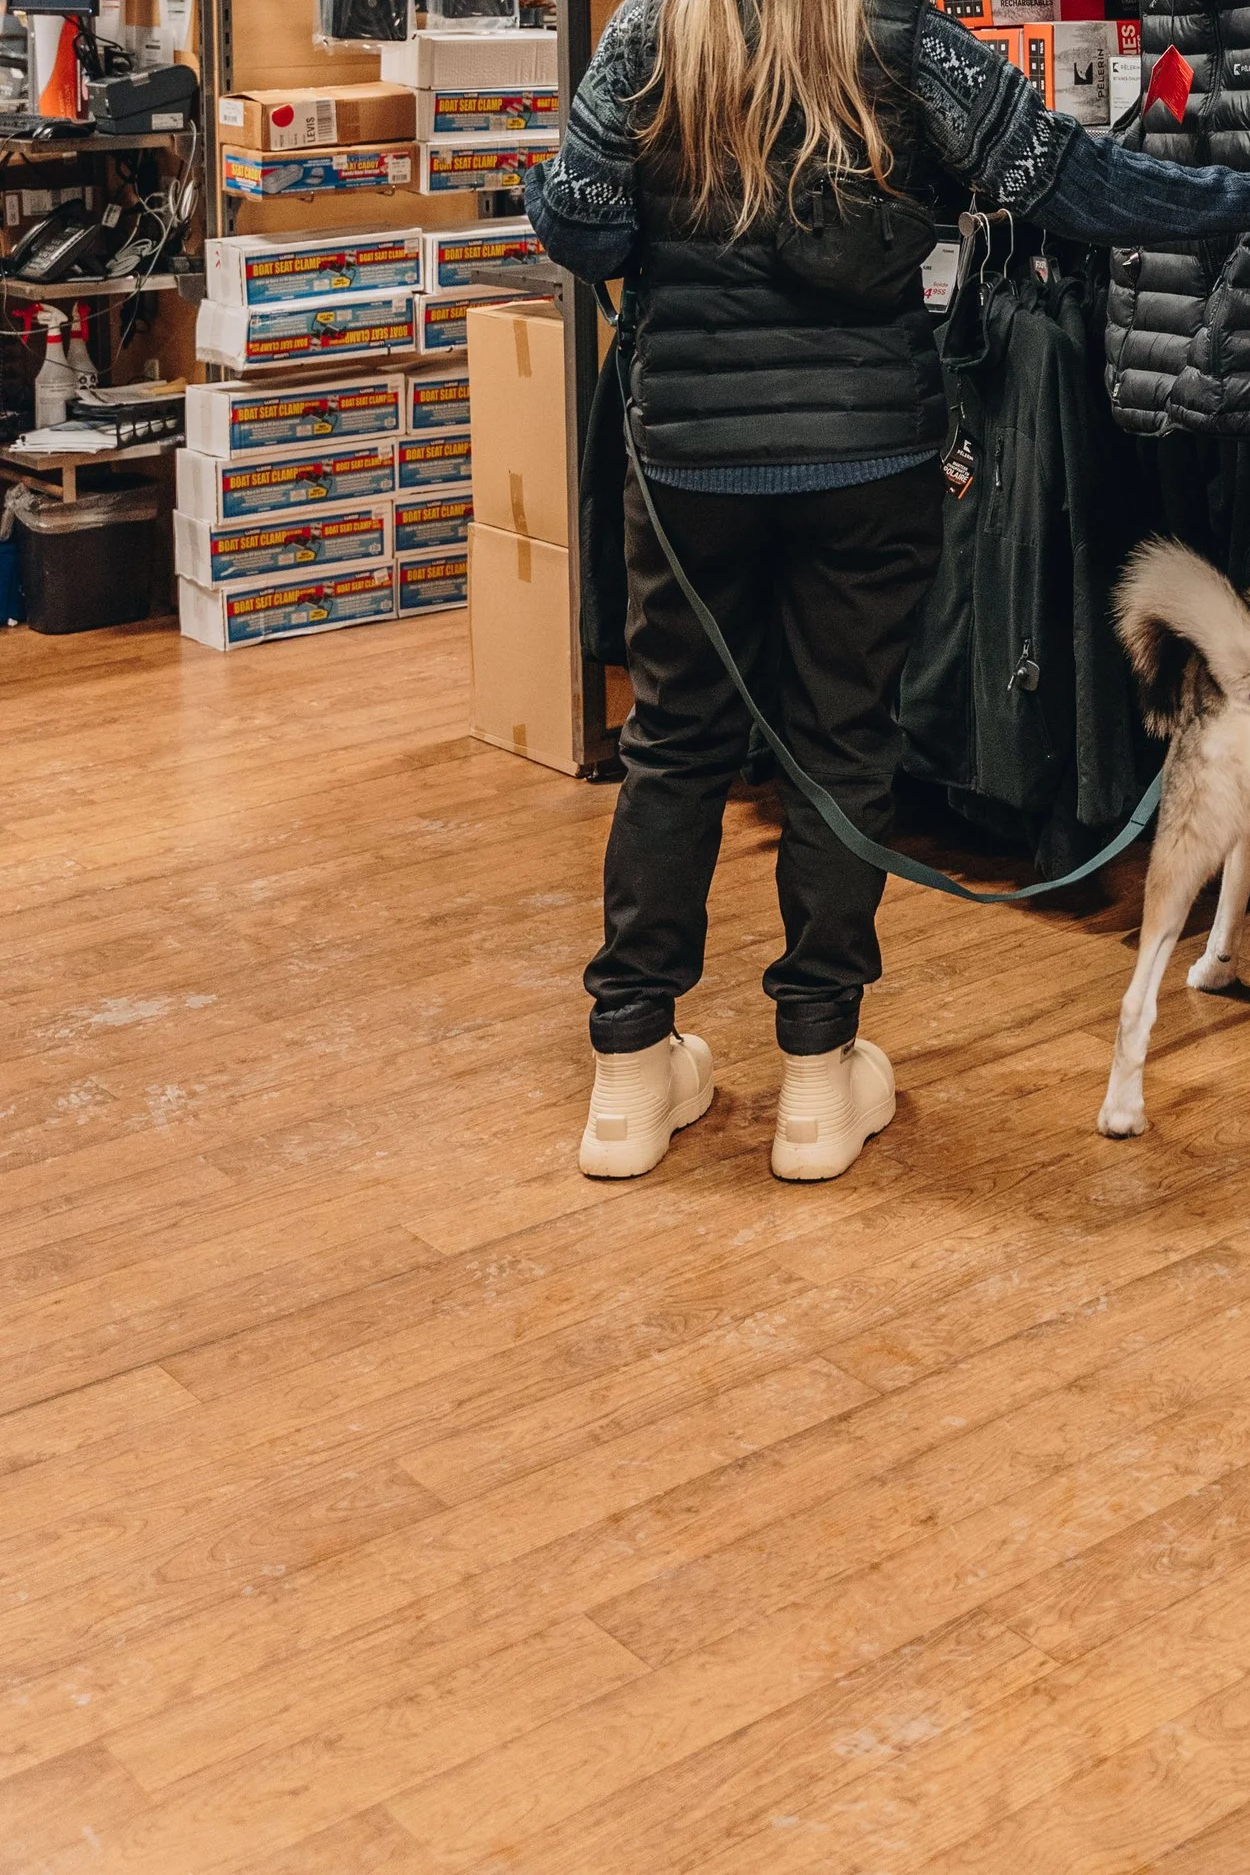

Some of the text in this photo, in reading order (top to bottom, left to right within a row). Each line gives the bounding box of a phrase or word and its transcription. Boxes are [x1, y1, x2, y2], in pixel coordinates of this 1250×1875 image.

[440, 98, 503, 112] BOAT SEAT CLAMP
[306, 117, 315, 143] LEVIS
[231, 165, 244, 177] SEAT
[445, 244, 507, 261] BOAT SEAT CLAMP
[252, 257, 322, 277] BOAT SEAT CLAMP
[238, 402, 305, 421] BOAT SEAT CLAMP
[406, 442, 469, 461] BOAT SEAT CLAMP
[230, 467, 299, 488] BOAT SEAT CLAMP
[218, 532, 288, 552] BOAT SEAT CLAMP
